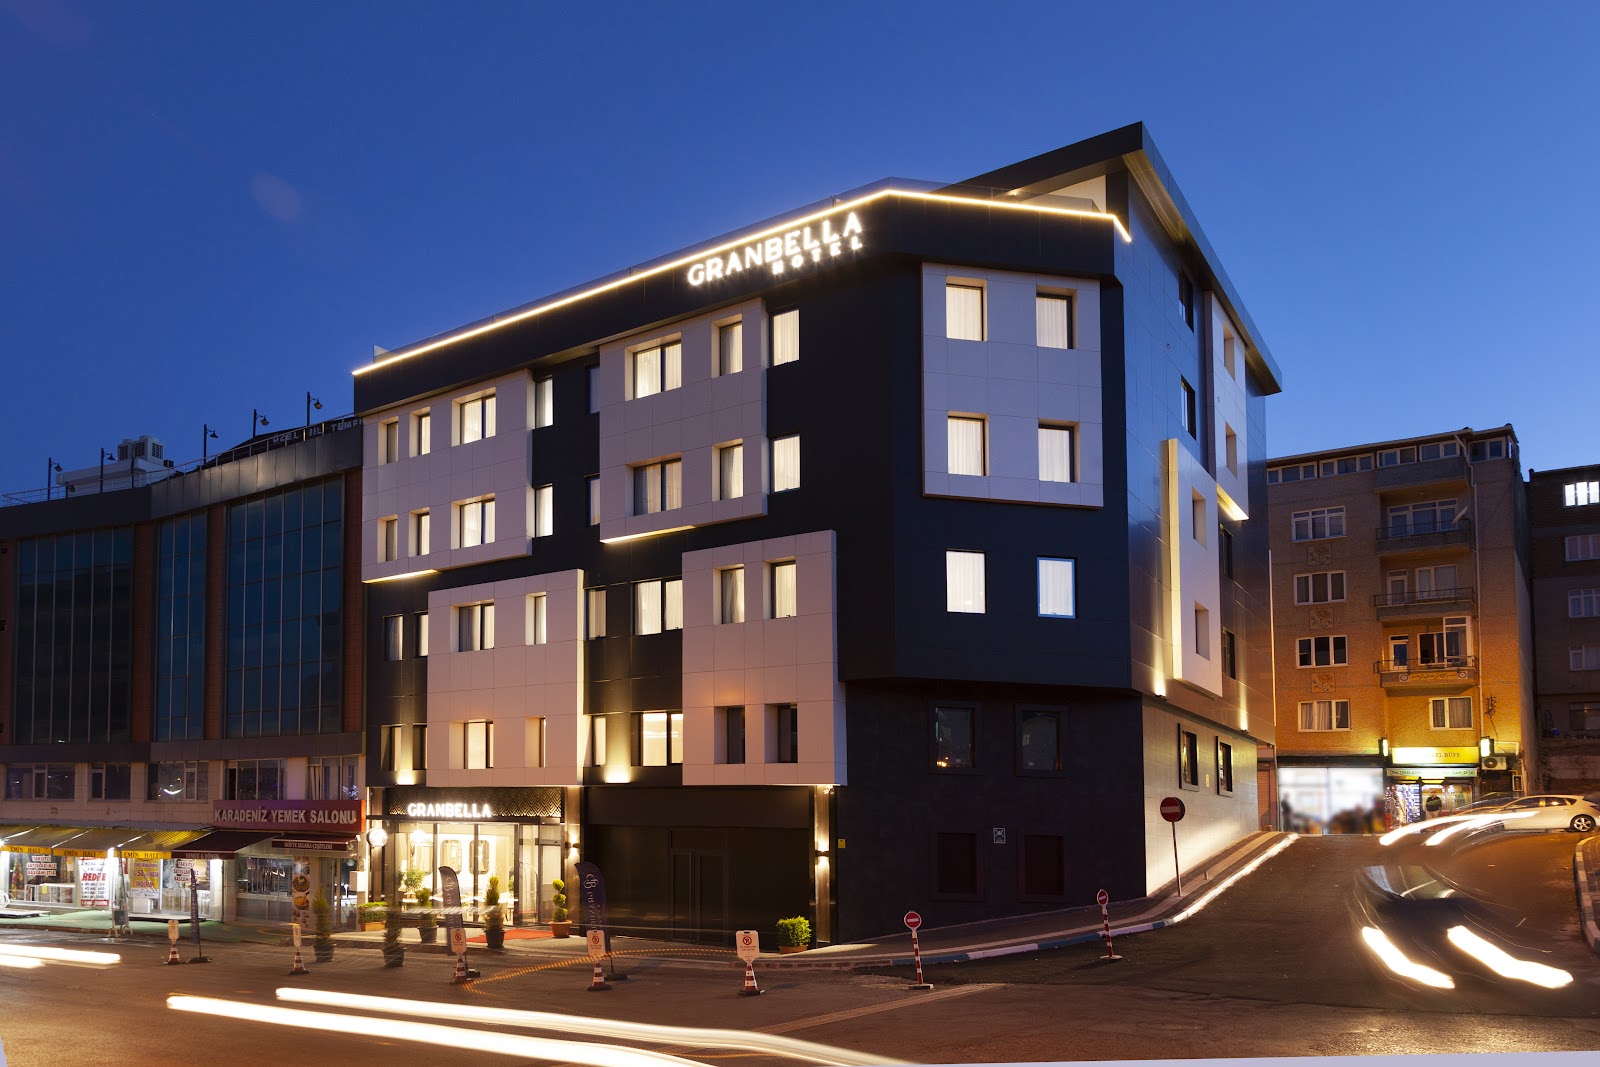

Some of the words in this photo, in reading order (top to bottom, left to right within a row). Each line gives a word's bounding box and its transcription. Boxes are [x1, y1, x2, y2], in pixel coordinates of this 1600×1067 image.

[687, 211, 863, 287] GRANBELLA
[772, 235, 863, 275] HOTEL
[213, 805, 268, 823] KARADENİZ
[270, 809, 306, 823] YEMEK
[309, 809, 357, 825] SALONU
[407, 802, 493, 818] GRANBELLA
[123, 850, 139, 858] EMİN
[81, 872, 107, 882] HEDİE
